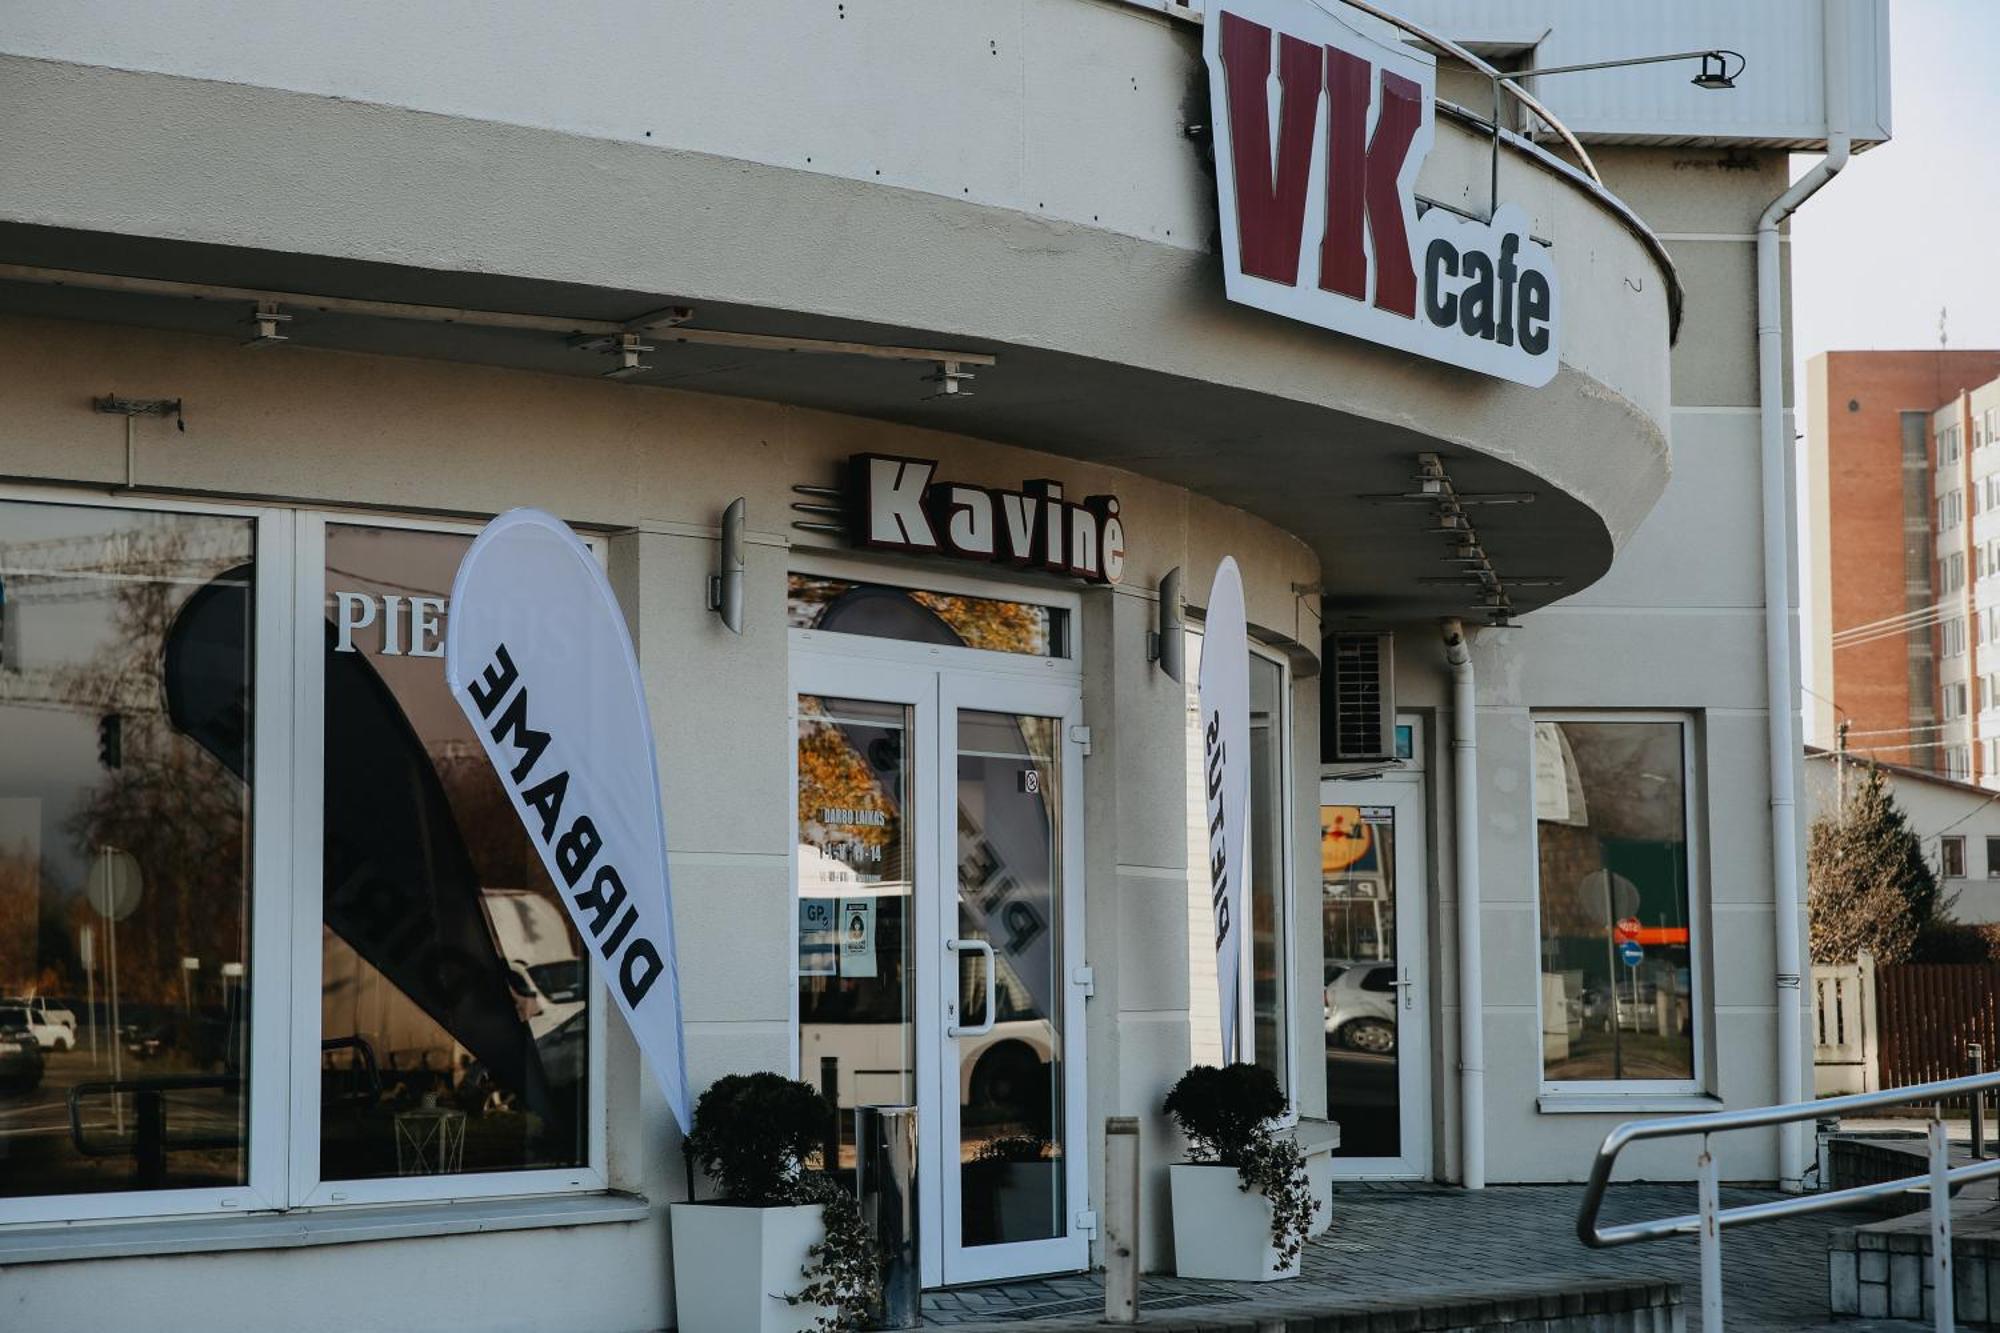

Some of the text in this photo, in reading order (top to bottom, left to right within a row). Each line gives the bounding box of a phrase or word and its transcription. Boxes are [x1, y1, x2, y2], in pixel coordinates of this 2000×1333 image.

[1218, 9, 1423, 321] VK
[868, 456, 1126, 586] Kavinė
[335, 591, 445, 658] PIE
